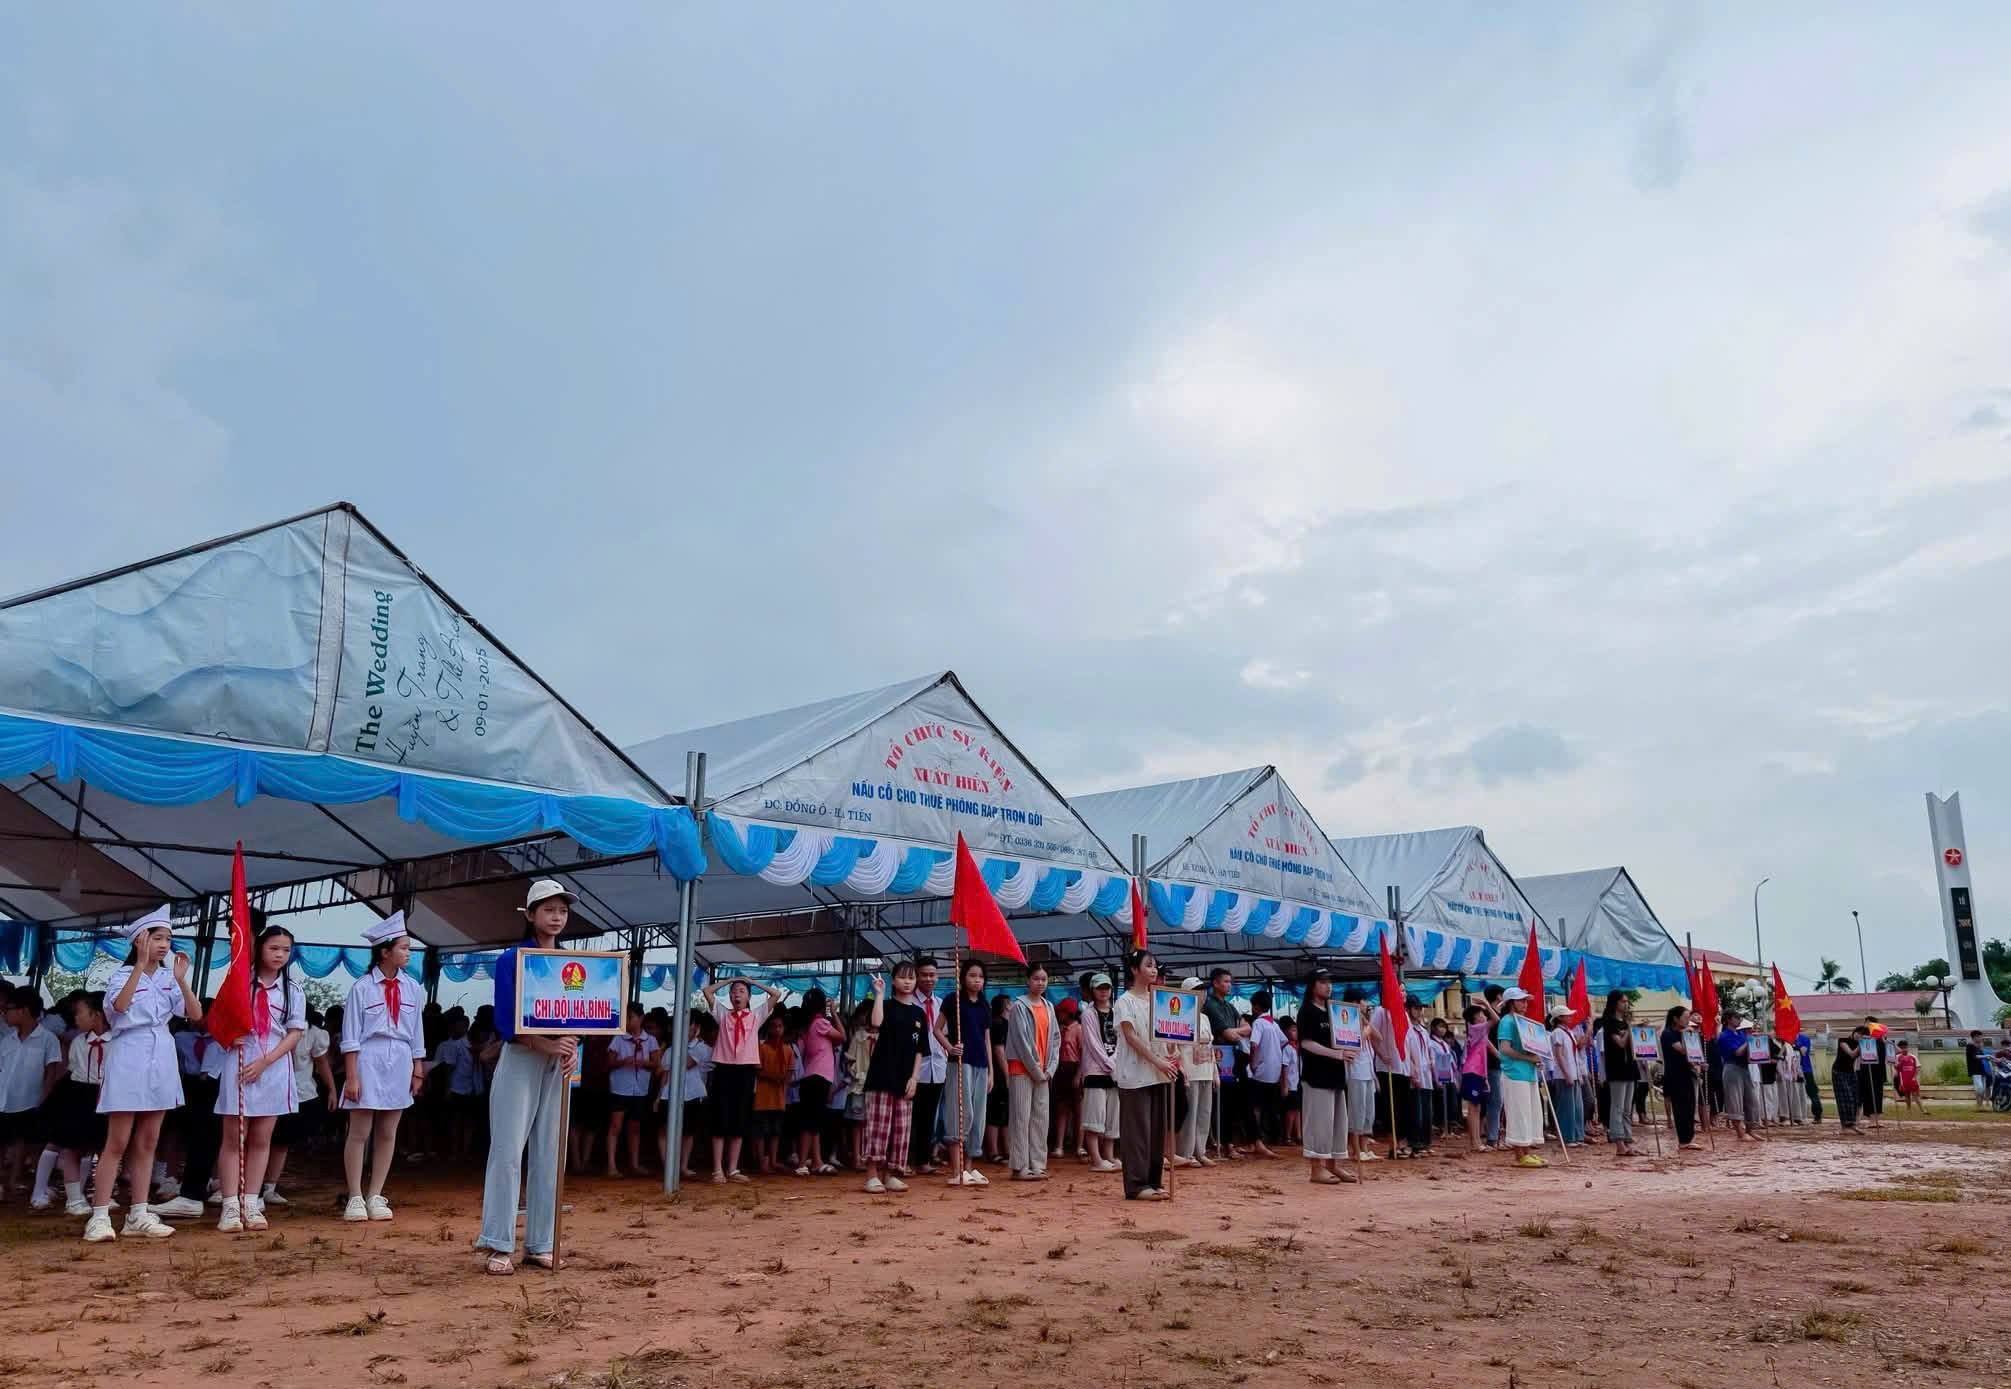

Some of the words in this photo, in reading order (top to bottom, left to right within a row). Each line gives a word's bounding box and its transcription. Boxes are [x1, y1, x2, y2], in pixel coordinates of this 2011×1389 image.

[365, 589, 393, 698] Wedding
[397, 631, 437, 697] Trang
[474, 648, 490, 737] 09-01-2025
[354, 704, 383, 753] The
[435, 709, 460, 731] &
[896, 787, 917, 804] CHO
[534, 999, 551, 1019] CHI
[554, 995, 570, 1024] ĐỘI
